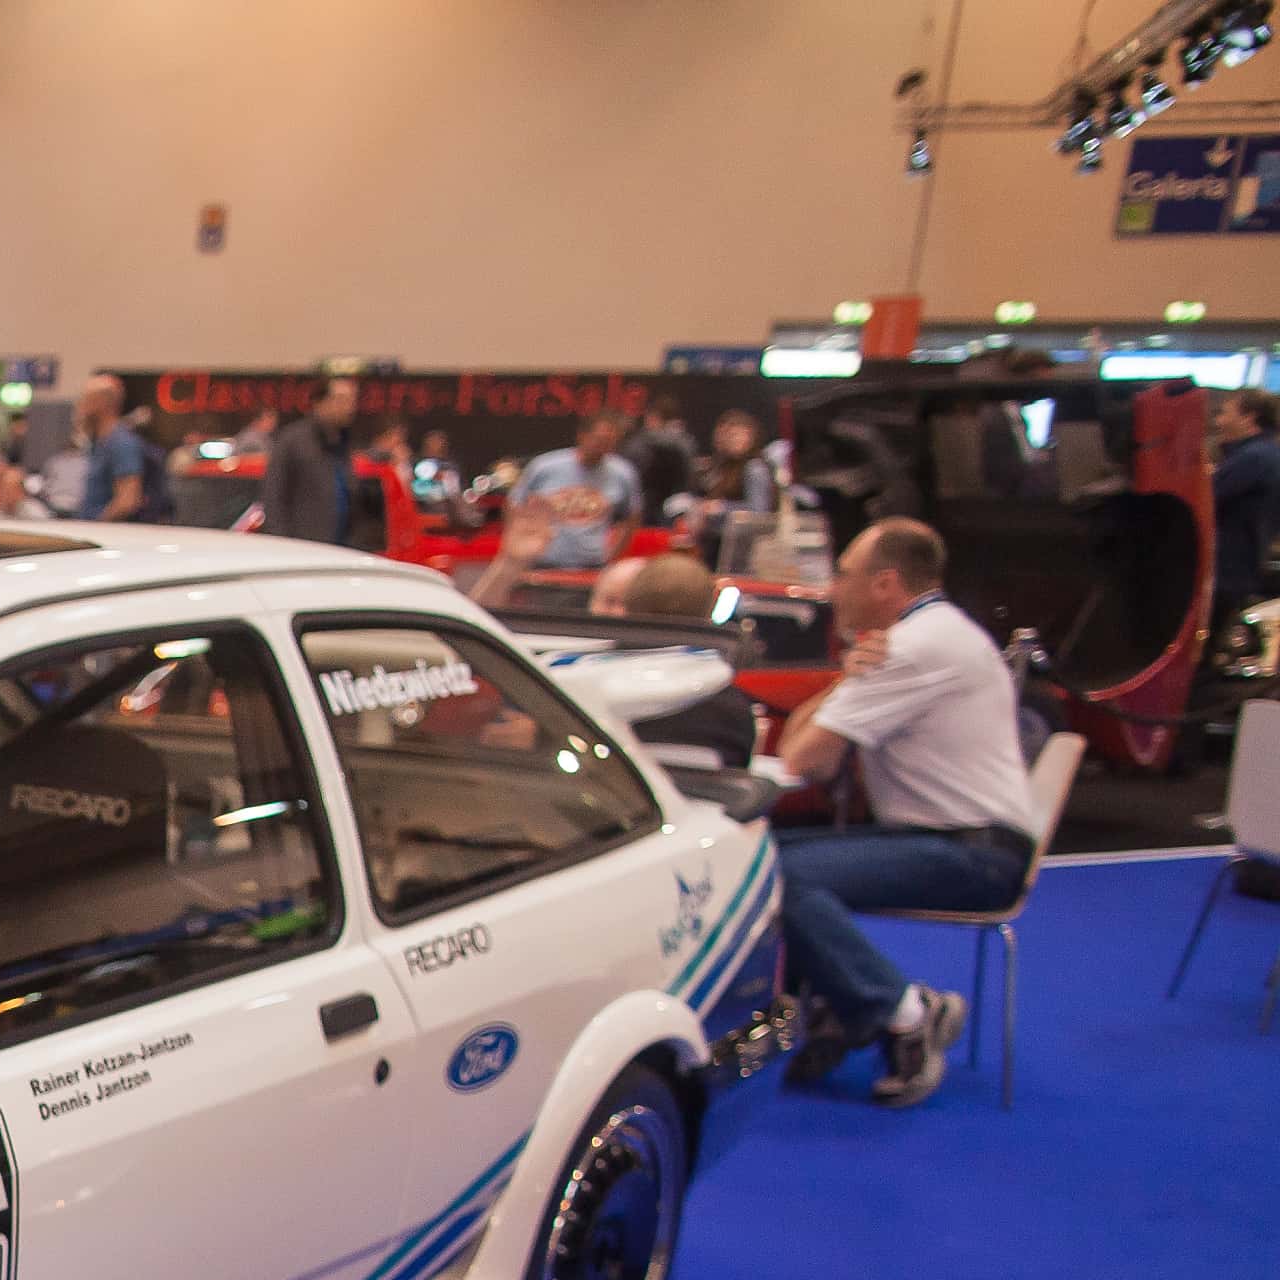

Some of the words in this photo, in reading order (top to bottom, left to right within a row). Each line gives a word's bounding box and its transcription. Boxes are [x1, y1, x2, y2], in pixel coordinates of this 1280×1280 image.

[402, 921, 493, 977] RECARO
[29, 1069, 80, 1097] Rainer
[38, 1089, 91, 1121] Dennis
